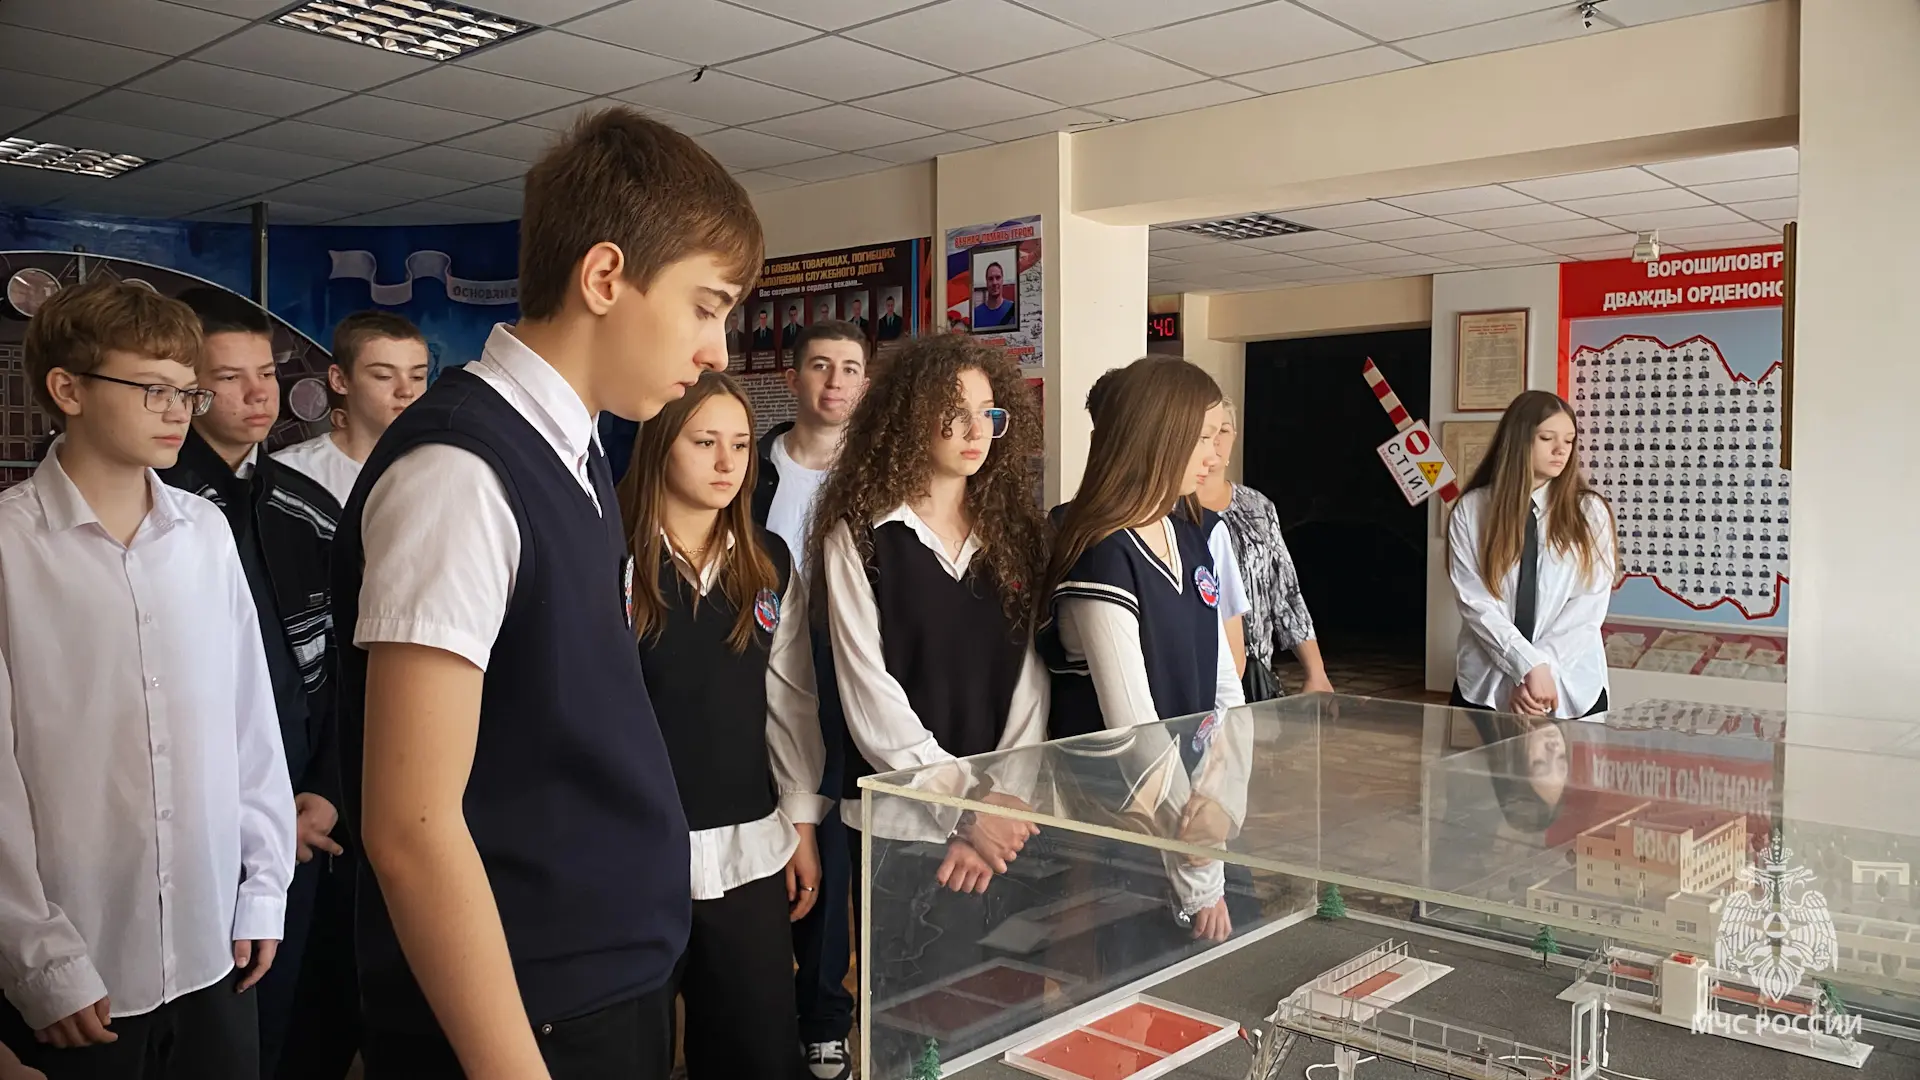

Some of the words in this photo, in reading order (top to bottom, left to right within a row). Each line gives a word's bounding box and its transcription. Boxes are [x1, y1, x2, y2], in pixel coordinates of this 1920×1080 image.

[1011, 226, 1034, 239] ГЕРОЮ
[771, 260, 800, 275] БОЕВЫХ
[801, 253, 850, 271] ТОВАРИЩАХ,
[851, 246, 896, 263] ПОГИБШИХ
[1647, 251, 1784, 278] ВОРОШИЛОВГР
[805, 267, 855, 282] СЛУЖЕБНОГО
[857, 262, 884, 277] ДОЛГА
[806, 282, 832, 293] сердцах
[1602, 287, 1683, 311] ДВАЖДЫ
